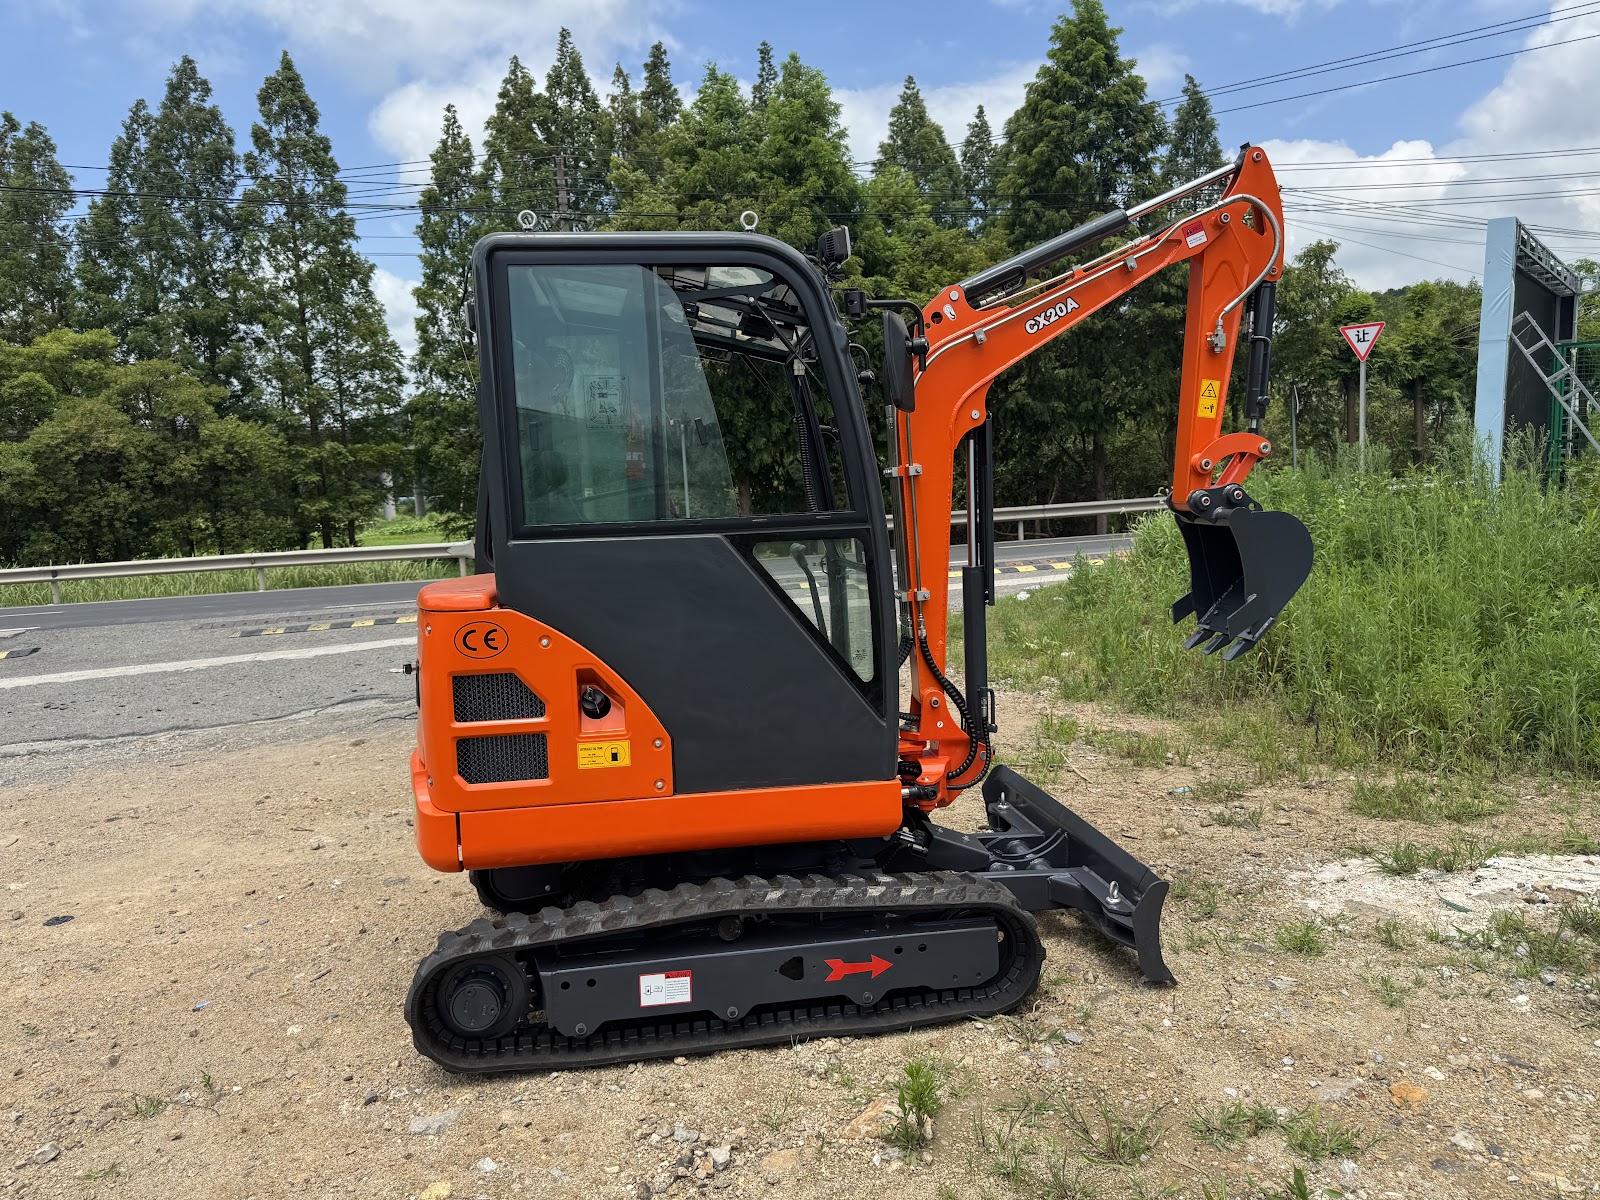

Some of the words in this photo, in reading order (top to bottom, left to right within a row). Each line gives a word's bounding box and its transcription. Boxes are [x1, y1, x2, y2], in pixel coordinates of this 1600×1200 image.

[1025, 296, 1080, 334] CX20A
[1355, 329, 1370, 343] 让
[463, 629, 498, 651] CE
